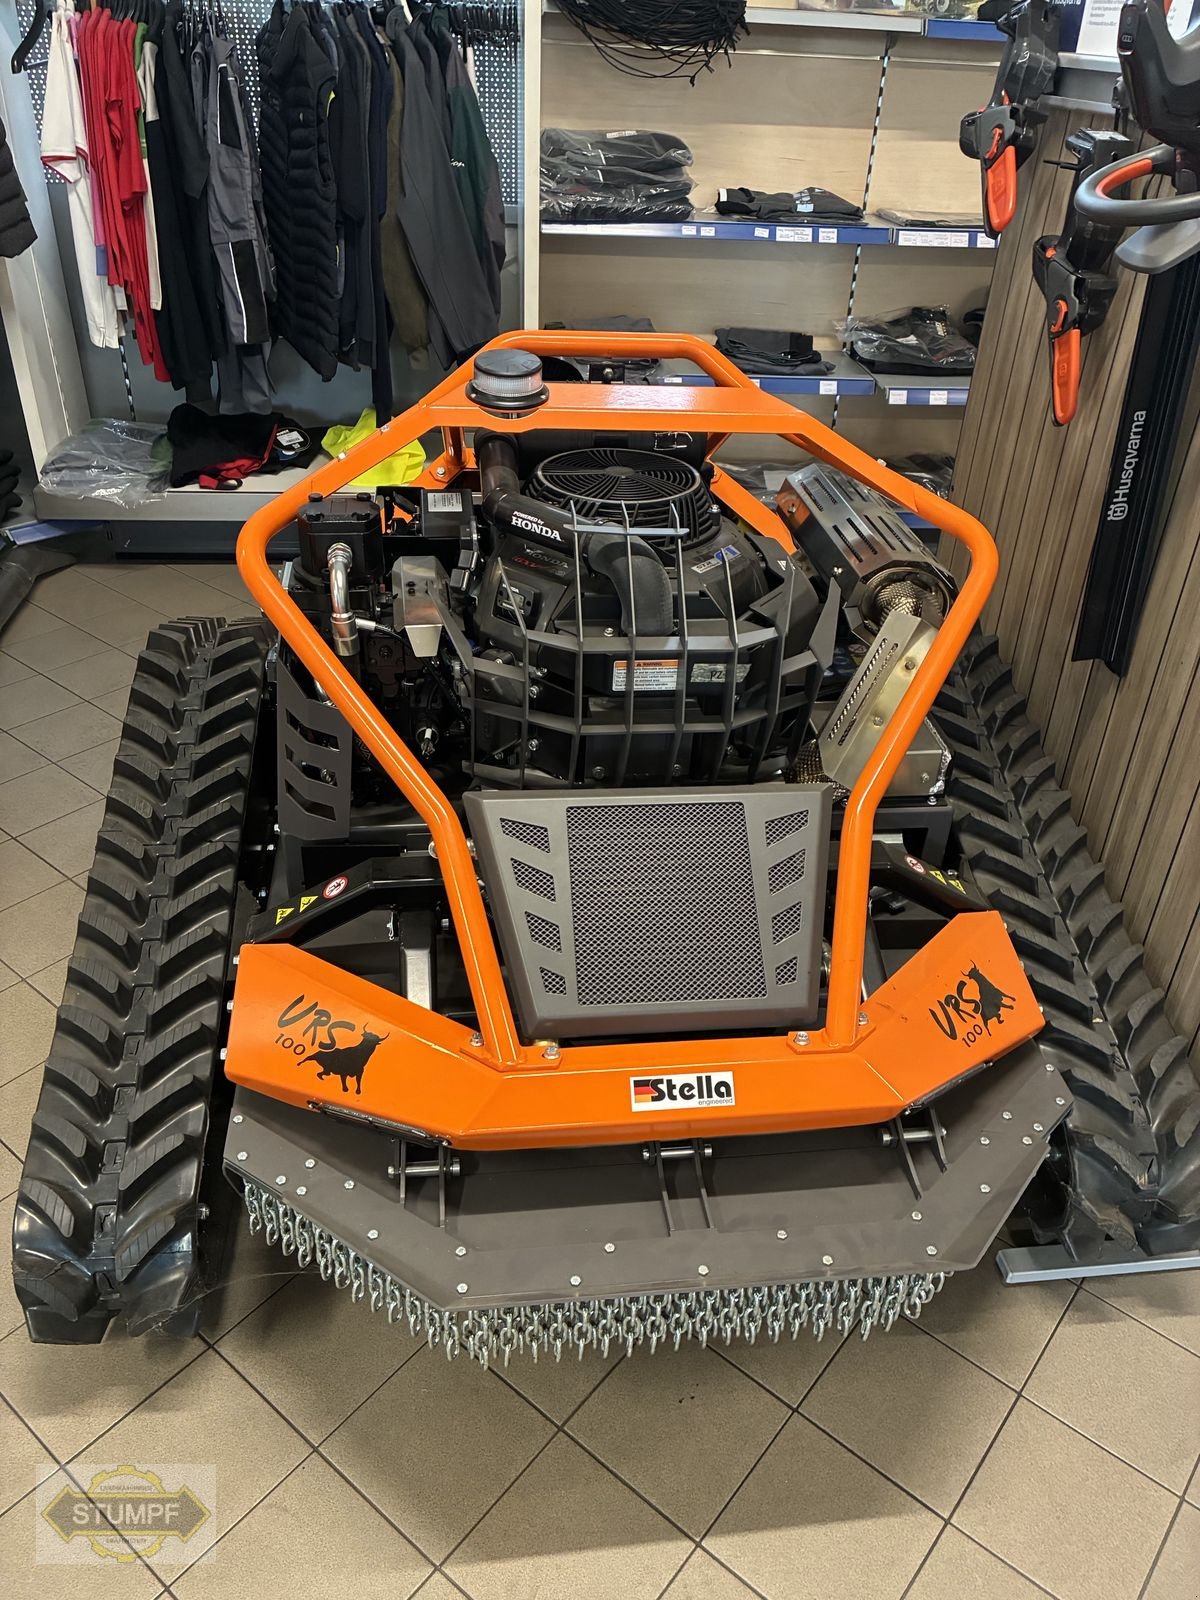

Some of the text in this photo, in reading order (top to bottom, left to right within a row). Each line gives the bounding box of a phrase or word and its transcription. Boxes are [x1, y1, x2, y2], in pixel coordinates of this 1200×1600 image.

[1113, 410, 1147, 503] Husqvarna
[511, 515, 562, 542] HONDA
[513, 511, 539, 523] POWERED
[278, 994, 356, 1051] URS
[929, 980, 981, 1041] URS
[275, 1033, 306, 1056] 100
[962, 1024, 983, 1048] 100
[650, 1075, 733, 1103] Stella
[697, 1097, 734, 1106] engineered
